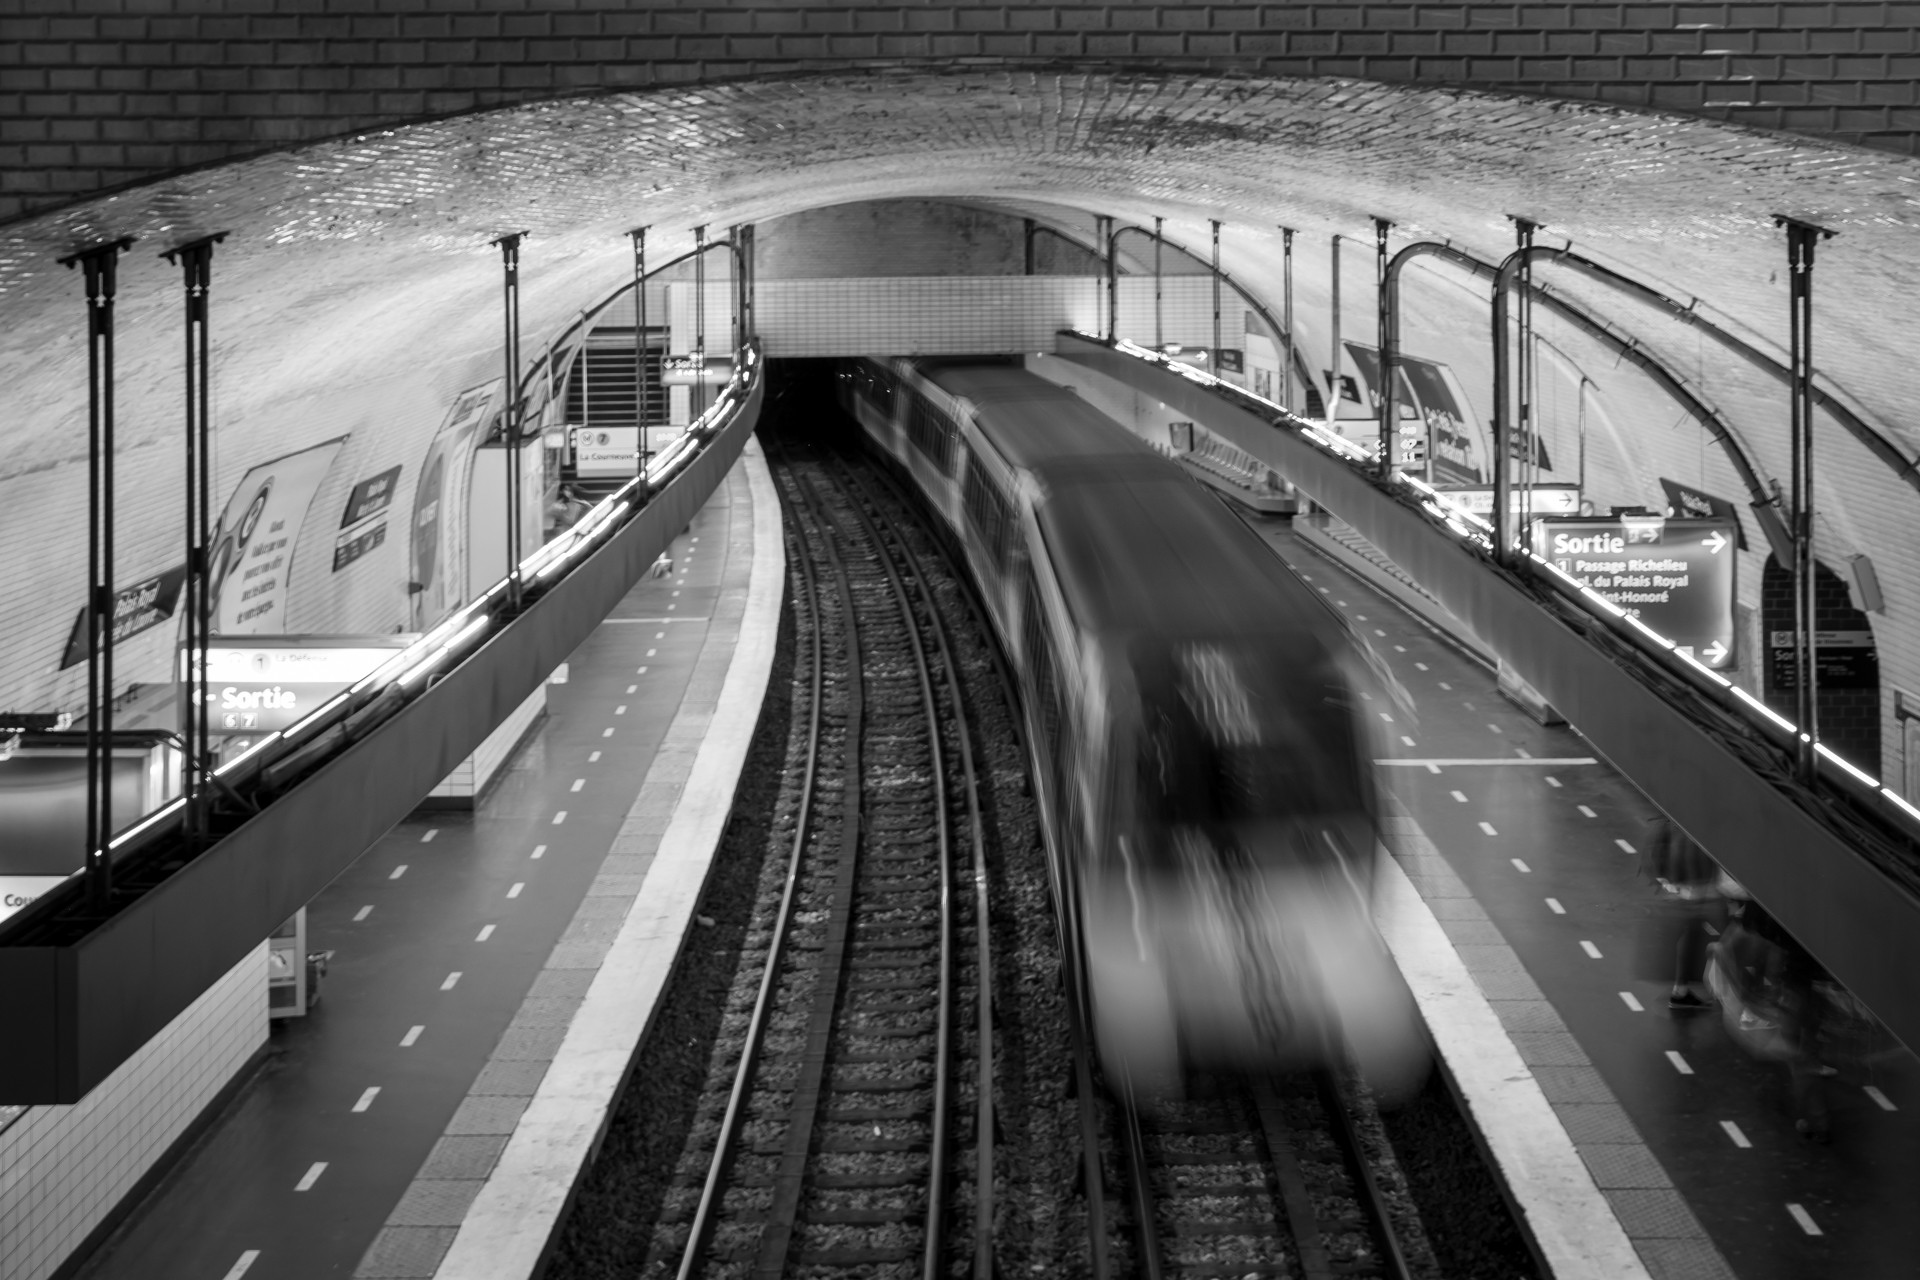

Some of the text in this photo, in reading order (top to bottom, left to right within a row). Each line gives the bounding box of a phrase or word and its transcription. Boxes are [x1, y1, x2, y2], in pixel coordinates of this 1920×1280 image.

[1554, 532, 1625, 554] Sortie
[1576, 559, 1626, 574] Passage
[1628, 558, 1688, 572] Richelieu
[1594, 575, 1611, 587] du
[1613, 575, 1651, 587] Palais
[1653, 575, 1689, 589] Royal
[1601, 591, 1669, 603] int-Honoré
[221, 686, 297, 709] Sortie
